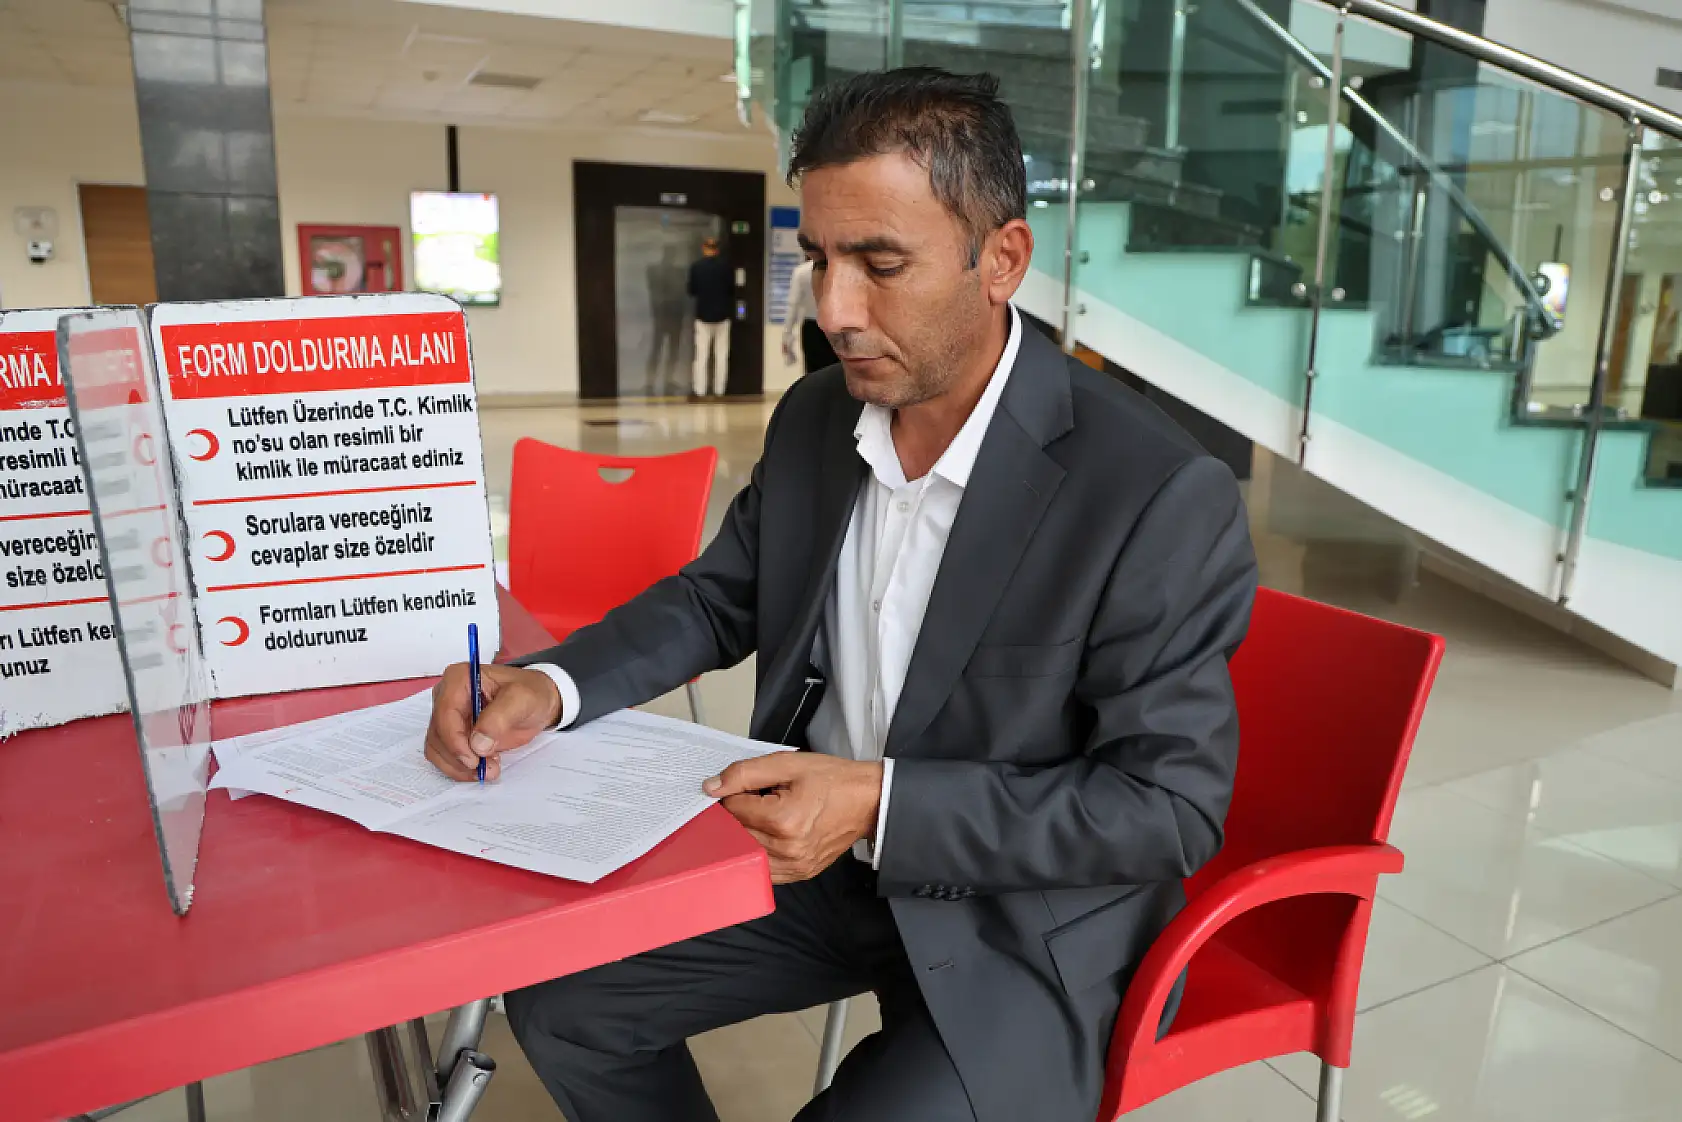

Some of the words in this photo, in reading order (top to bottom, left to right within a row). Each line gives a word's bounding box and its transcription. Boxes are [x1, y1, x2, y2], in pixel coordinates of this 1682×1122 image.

[177, 342, 248, 378] FORM
[253, 335, 386, 374] DOLDURMA
[391, 331, 457, 366] ALANI
[227, 405, 289, 428] Lütfen
[292, 399, 374, 423] Üzerinde
[378, 397, 413, 419] T.C.
[418, 394, 474, 415] Kimlik
[233, 434, 284, 454] no'su
[289, 431, 329, 450] olan
[334, 426, 394, 448] resimli
[400, 424, 424, 443] bir
[0, 446, 67, 471] resimli
[236, 459, 292, 481] kimlik
[297, 456, 319, 477] ile
[323, 452, 408, 475] müracaat
[412, 448, 464, 469] ediniz
[245, 512, 326, 536] Sorulara
[329, 502, 433, 530] vereceğiniz
[251, 541, 329, 568] cevaplar
[334, 538, 370, 559] size
[375, 532, 435, 555] özeldir
[6, 565, 48, 587] size
[260, 601, 336, 624] Formları
[340, 596, 398, 617] Lütfen
[402, 589, 477, 612] kendiniz
[17, 624, 83, 648] Lütfen
[265, 627, 368, 651] doldurunuz
